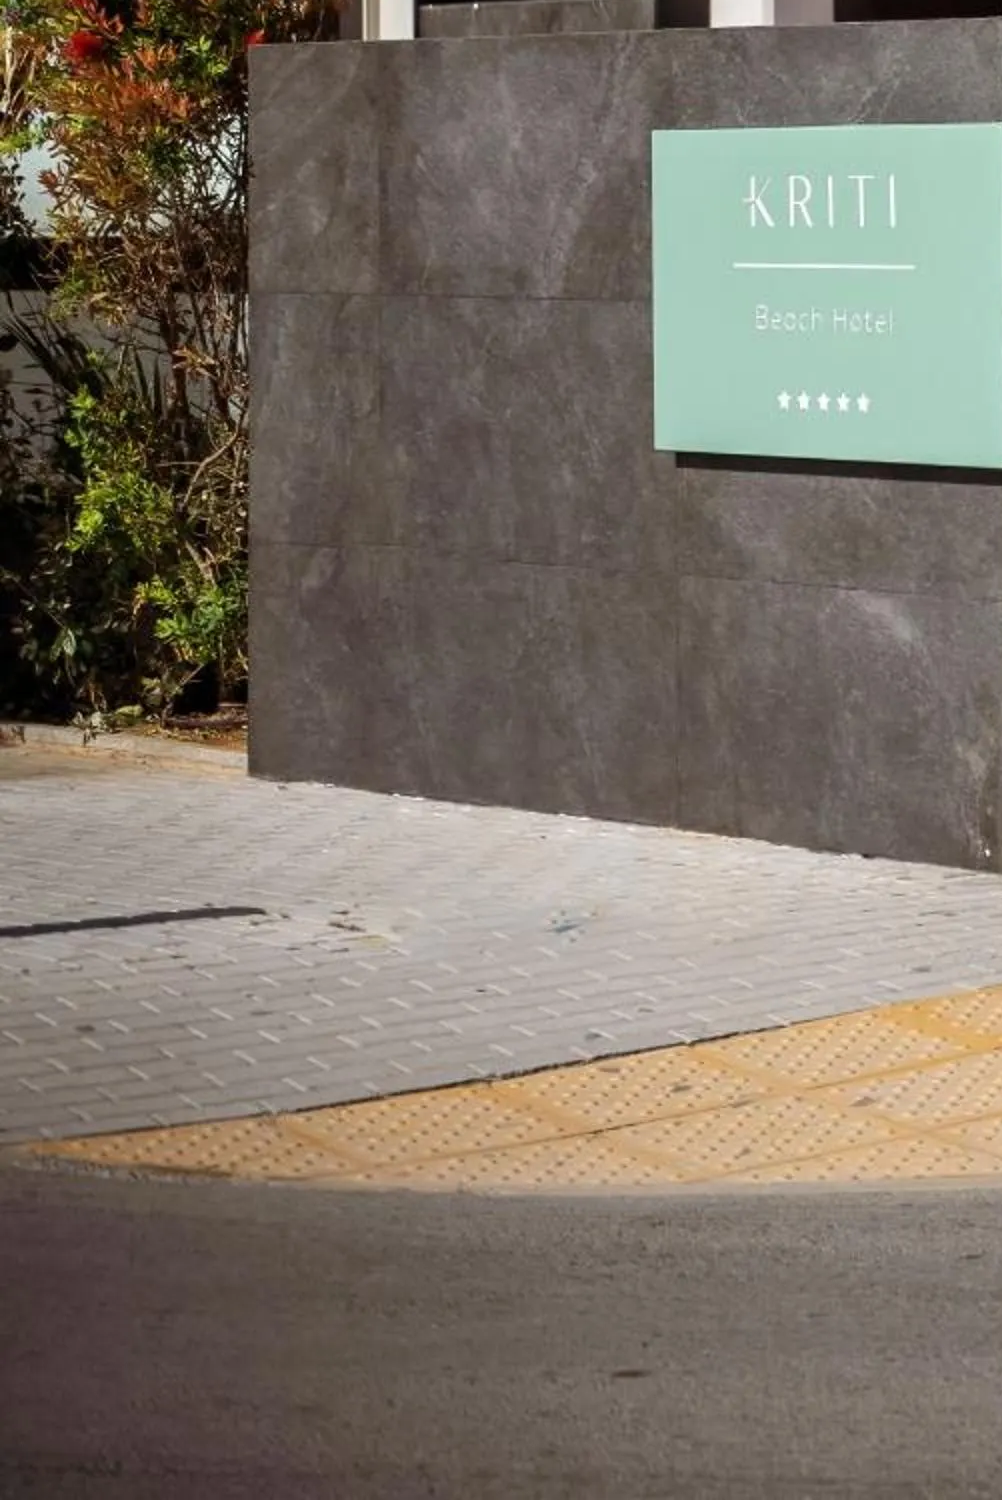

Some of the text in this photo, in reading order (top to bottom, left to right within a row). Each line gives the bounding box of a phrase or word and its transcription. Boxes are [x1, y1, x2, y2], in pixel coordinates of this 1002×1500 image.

[743, 174, 897, 228] KRITI
[755, 304, 895, 335] Beach Hotel
